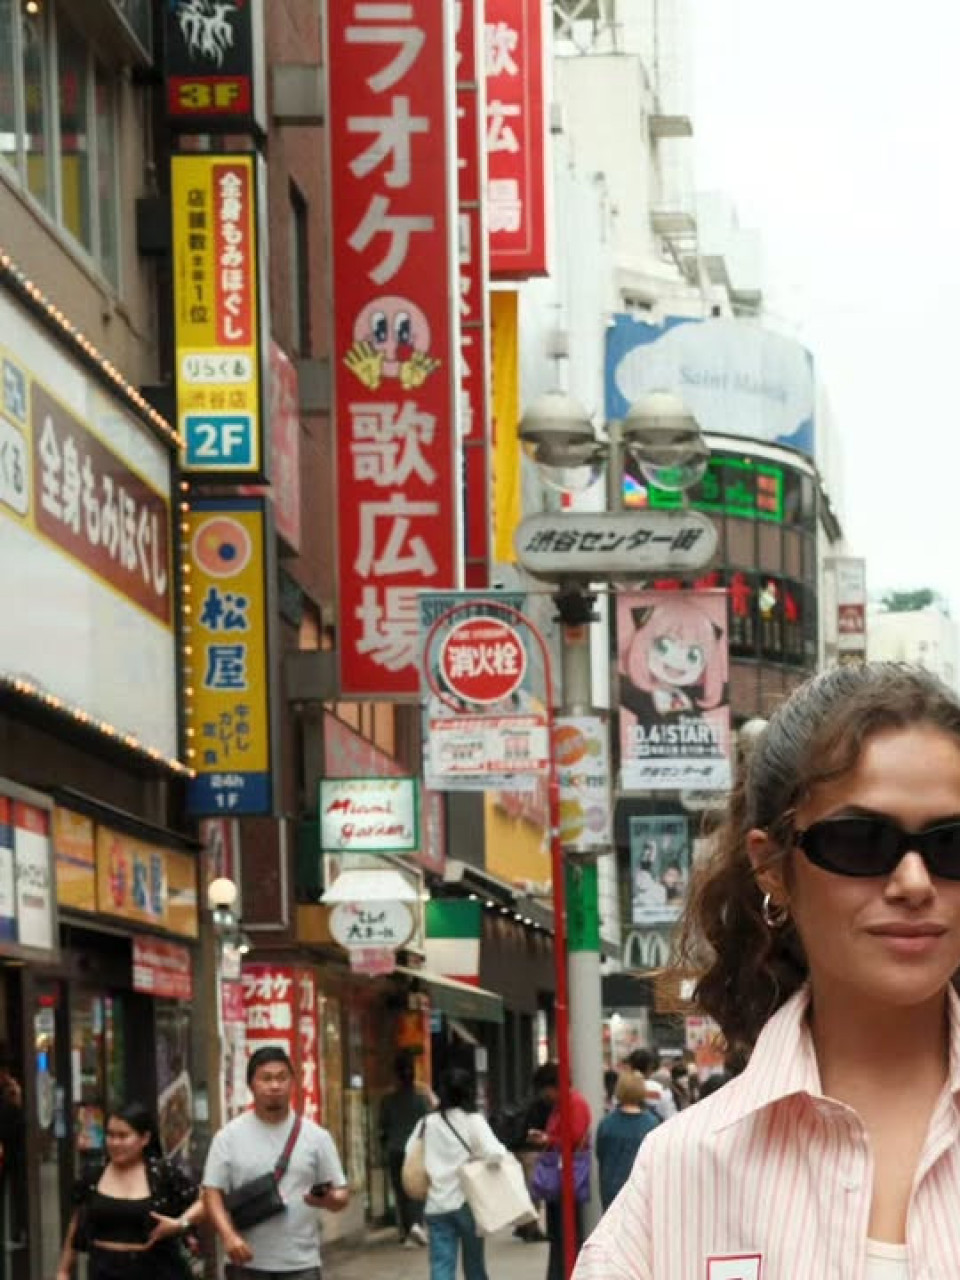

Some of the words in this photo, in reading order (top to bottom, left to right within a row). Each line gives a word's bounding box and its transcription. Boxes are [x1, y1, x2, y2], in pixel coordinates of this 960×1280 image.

[179, 83, 240, 108] 3F
[195, 423, 245, 457] 2F
[38, 414, 168, 597] 全身もみほぐし
[200, 586, 250, 689] 松屋
[448, 642, 520, 678] 消火栓
[215, 792, 238, 807] 1F
